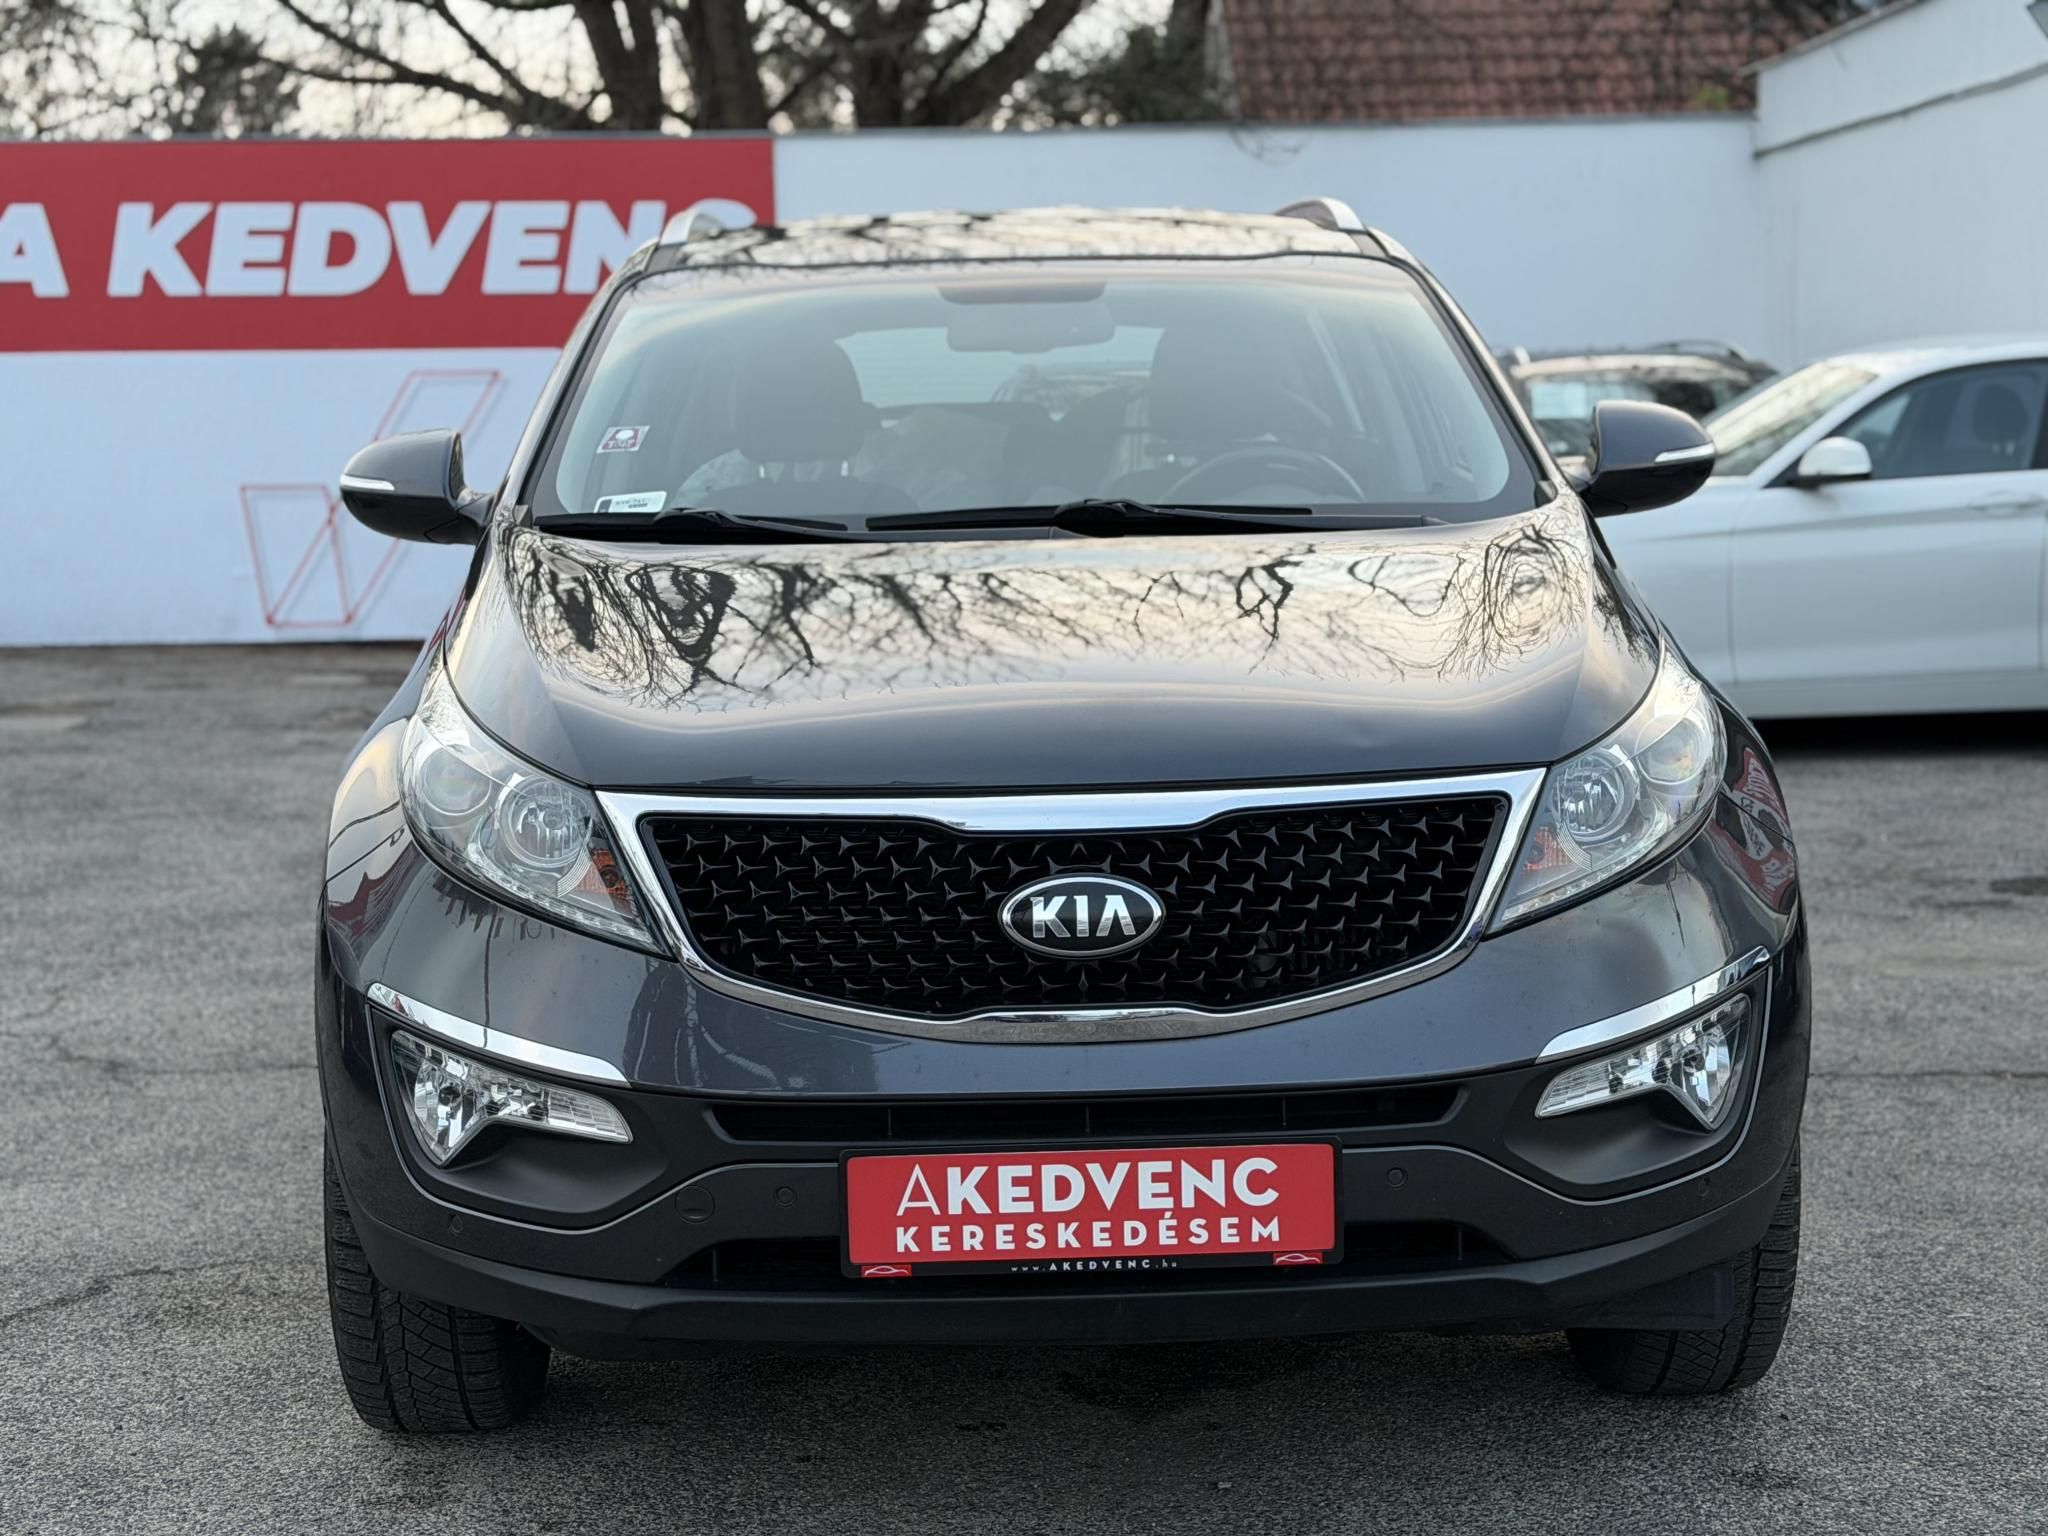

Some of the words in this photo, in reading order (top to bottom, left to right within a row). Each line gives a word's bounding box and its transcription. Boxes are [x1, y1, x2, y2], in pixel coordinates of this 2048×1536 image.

[0, 202, 70, 297] A
[1030, 894, 1136, 938] KIA
[896, 1157, 1280, 1216] AKEDVENC
[896, 1212, 1280, 1253] KERESKEDÉSEM
[1011, 1259, 1177, 1272] www.AKEDVENC.hu
